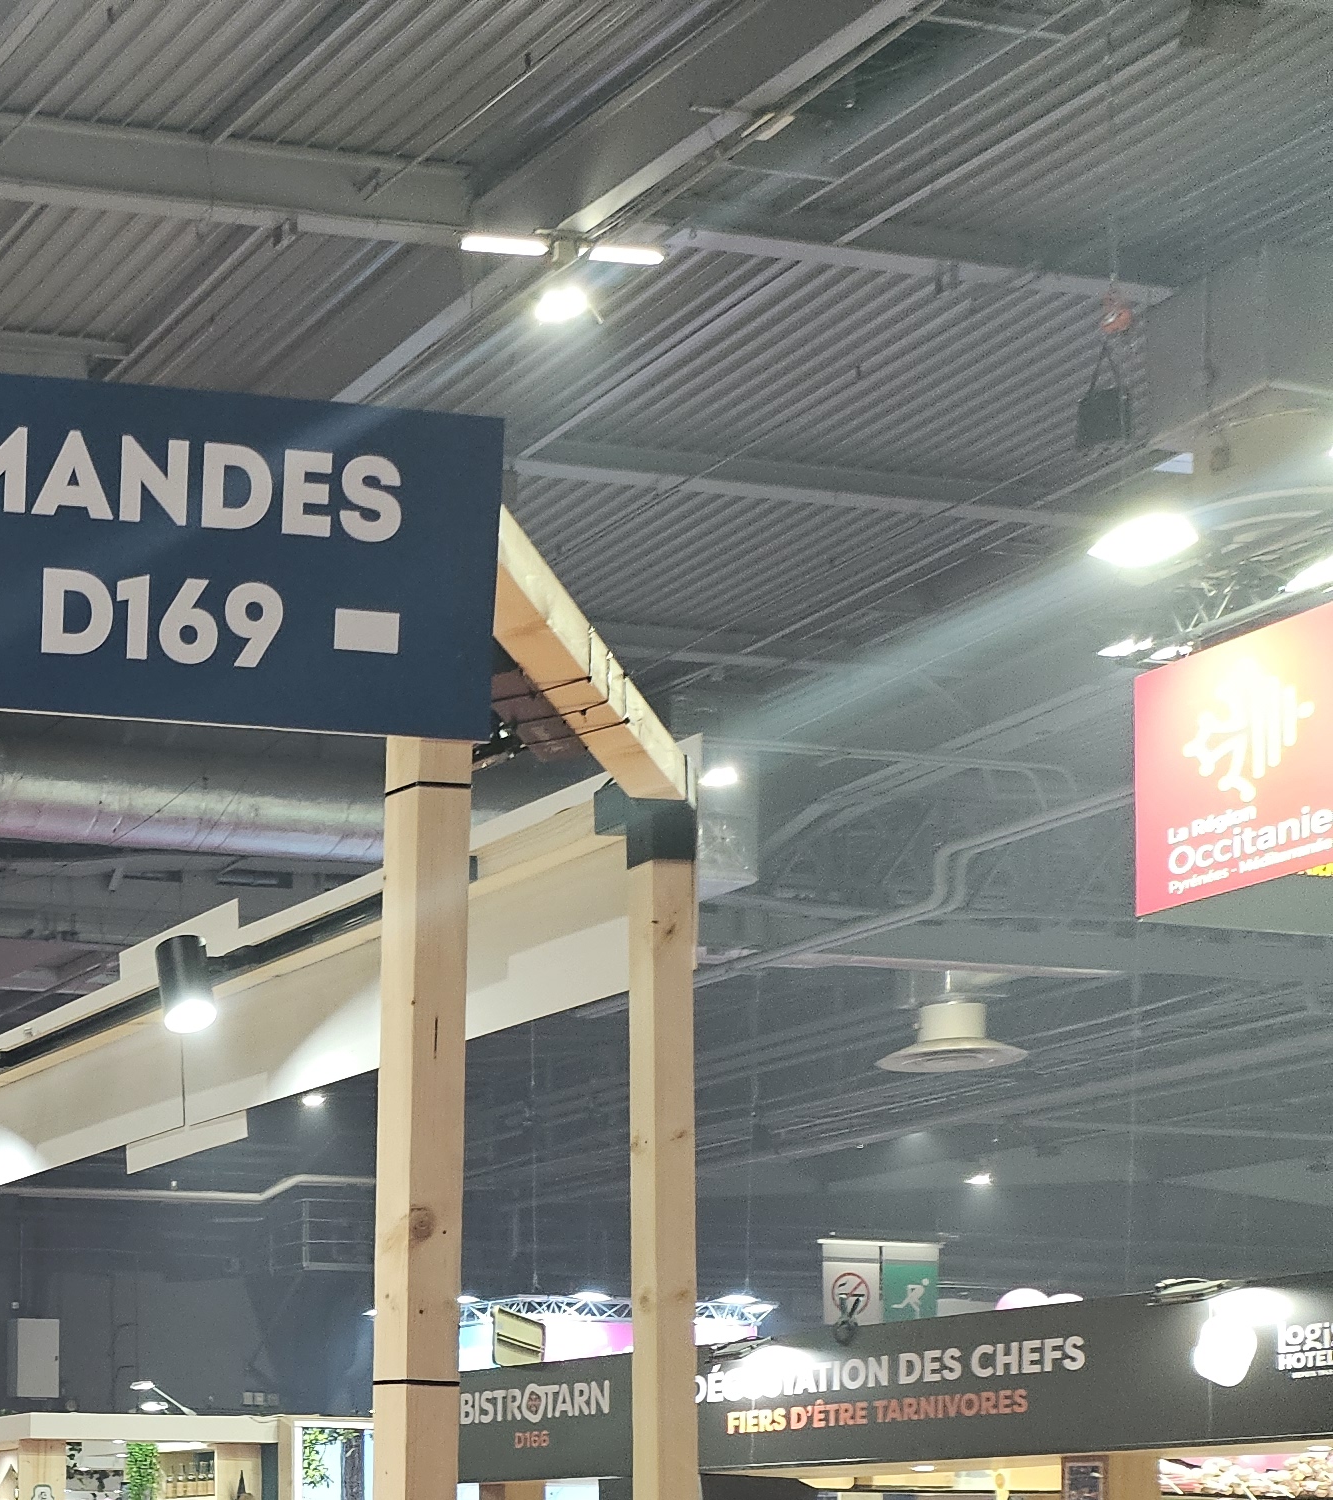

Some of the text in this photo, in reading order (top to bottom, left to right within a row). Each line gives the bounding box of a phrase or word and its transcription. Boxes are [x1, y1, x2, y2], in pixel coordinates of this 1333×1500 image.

[42, 567, 284, 668] D169
[1168, 805, 1333, 875] Occitanie
[1277, 1319, 1333, 1353] Logi
[694, 1335, 1086, 1404] DÉGTATION DES CHEFS
[459, 1379, 610, 1425] BISTROTARN
[727, 1388, 1029, 1435] FIERS D'ÊTRE TARNIVORES
[514, 1430, 550, 1449] D166
